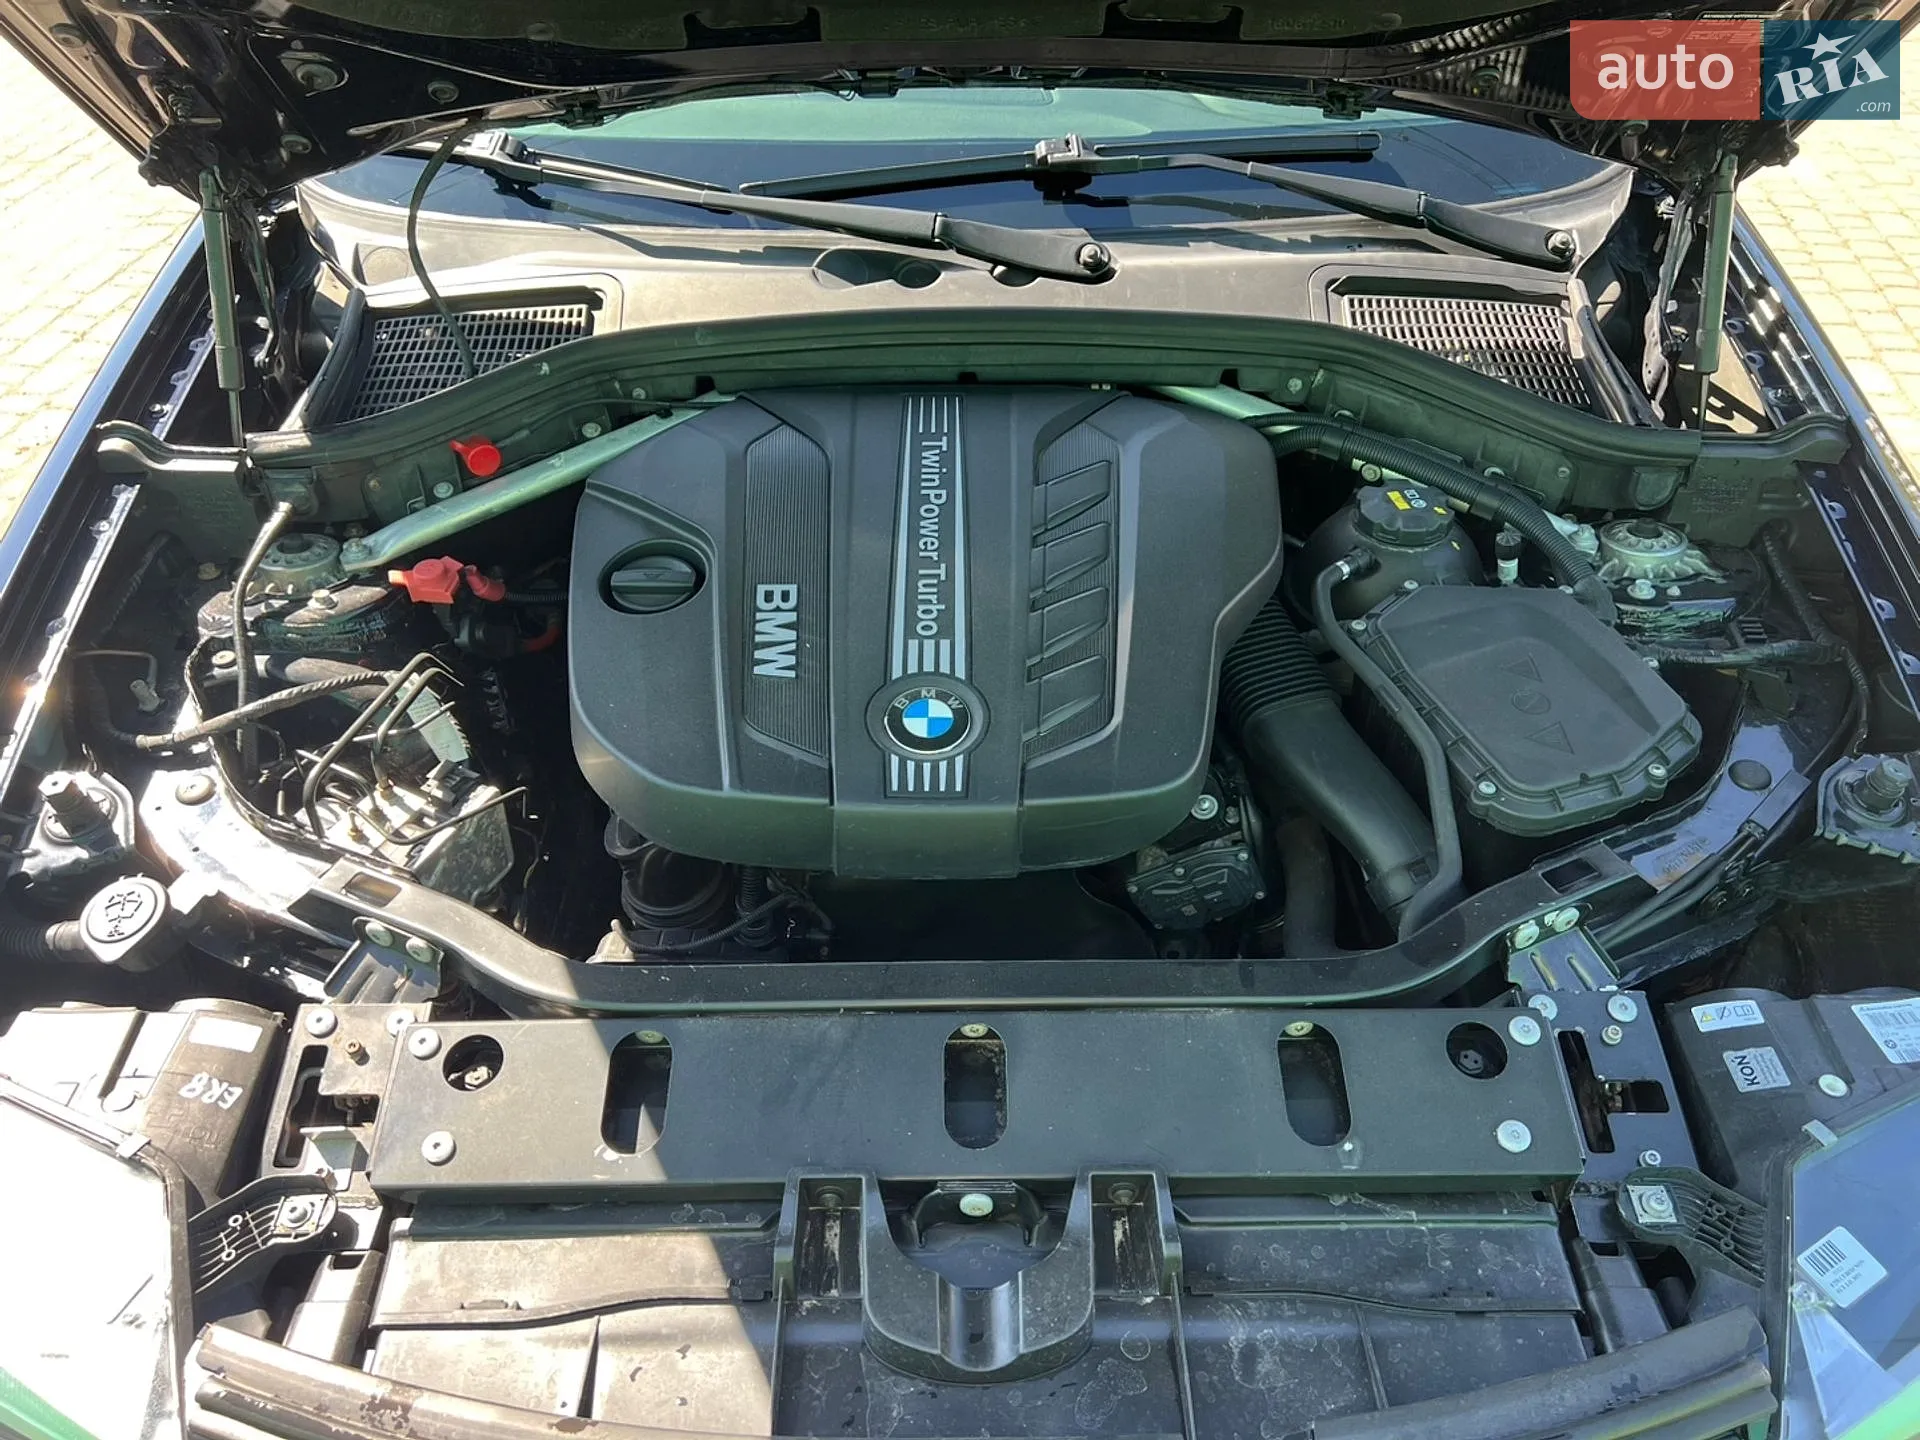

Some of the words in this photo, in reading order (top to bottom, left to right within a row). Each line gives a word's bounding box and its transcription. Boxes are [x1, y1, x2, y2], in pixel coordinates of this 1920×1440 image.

[918, 436, 948, 561] TwinPower
[753, 583, 798, 679] BMW
[916, 563, 947, 637] Turbo
[894, 687, 964, 710] BMW
